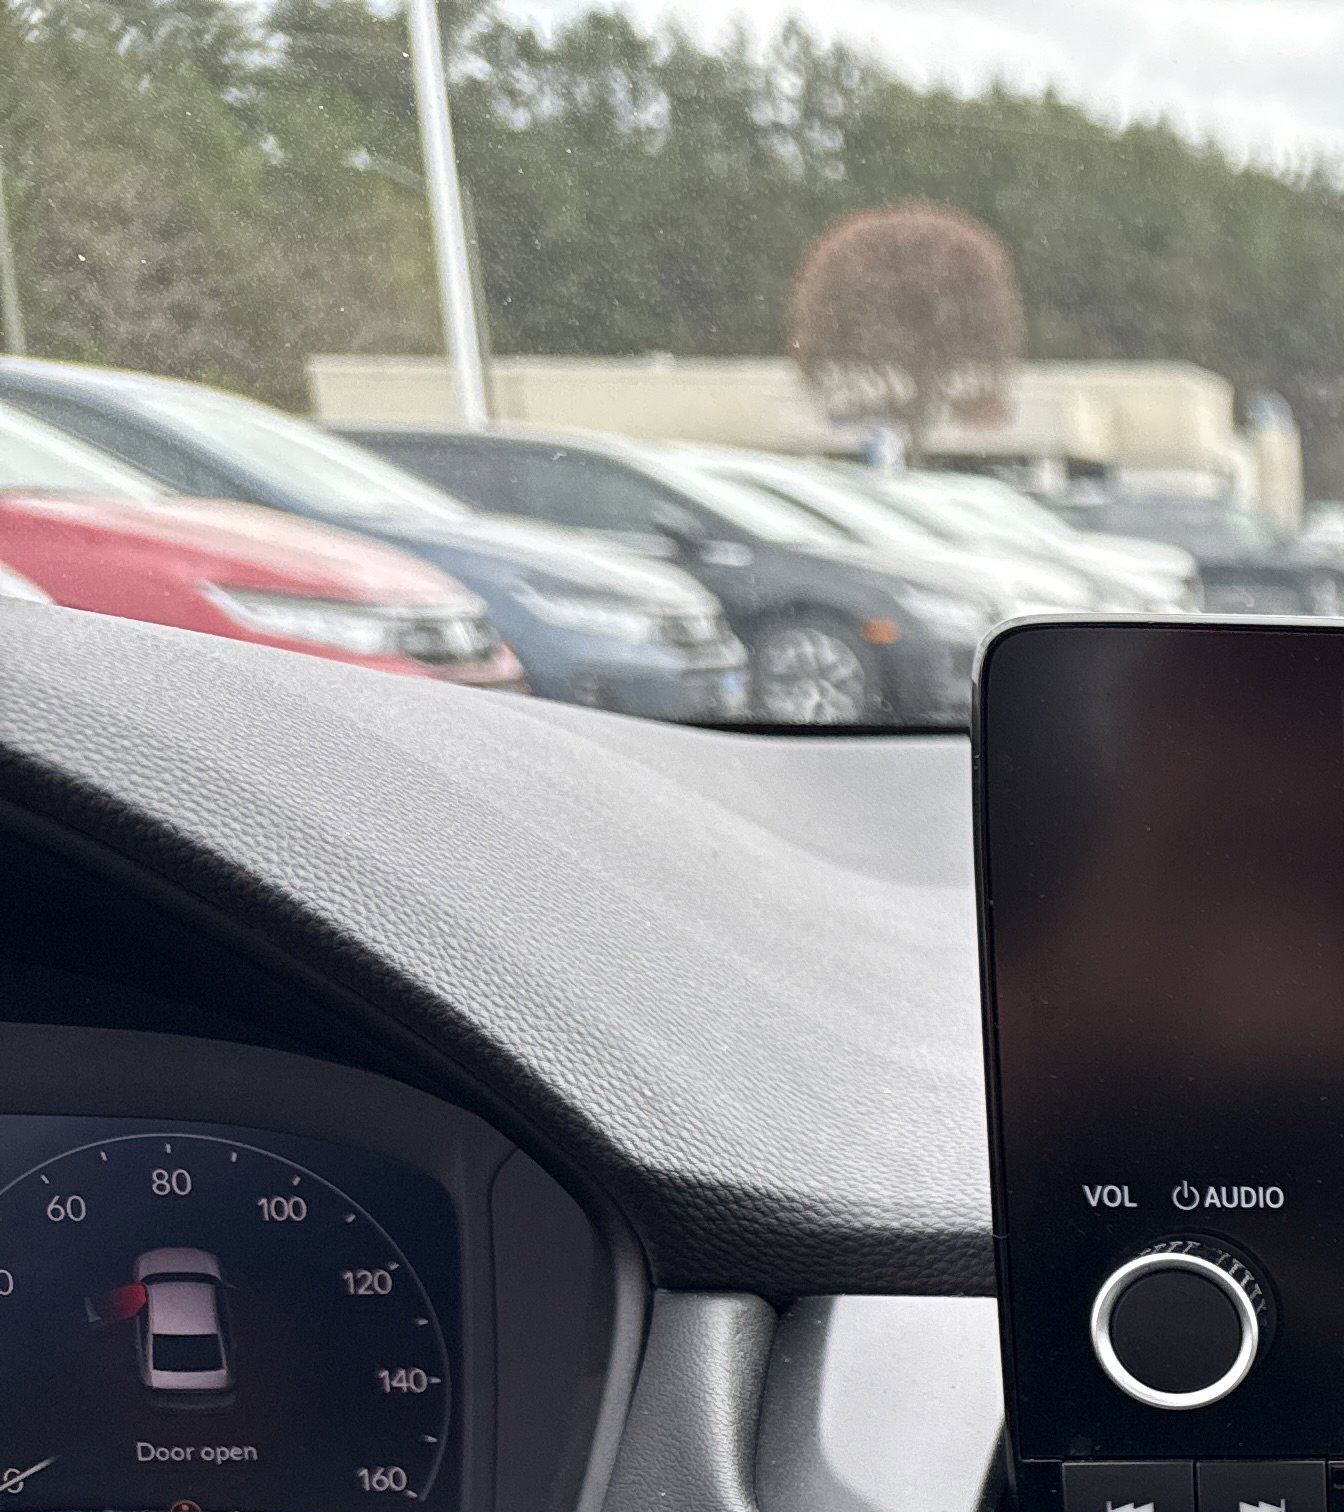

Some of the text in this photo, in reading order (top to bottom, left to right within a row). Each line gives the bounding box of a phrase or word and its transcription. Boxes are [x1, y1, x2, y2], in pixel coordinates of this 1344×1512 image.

[151, 1170, 192, 1196] 80
[1083, 1184, 1137, 1208] VOL
[46, 1195, 87, 1222] 60
[257, 1196, 307, 1222] 100
[1204, 1186, 1285, 1209] AUDIO
[342, 1269, 392, 1296] 120
[378, 1368, 427, 1394] 140
[136, 1441, 258, 1466] Door open
[357, 1466, 407, 1493] 160
